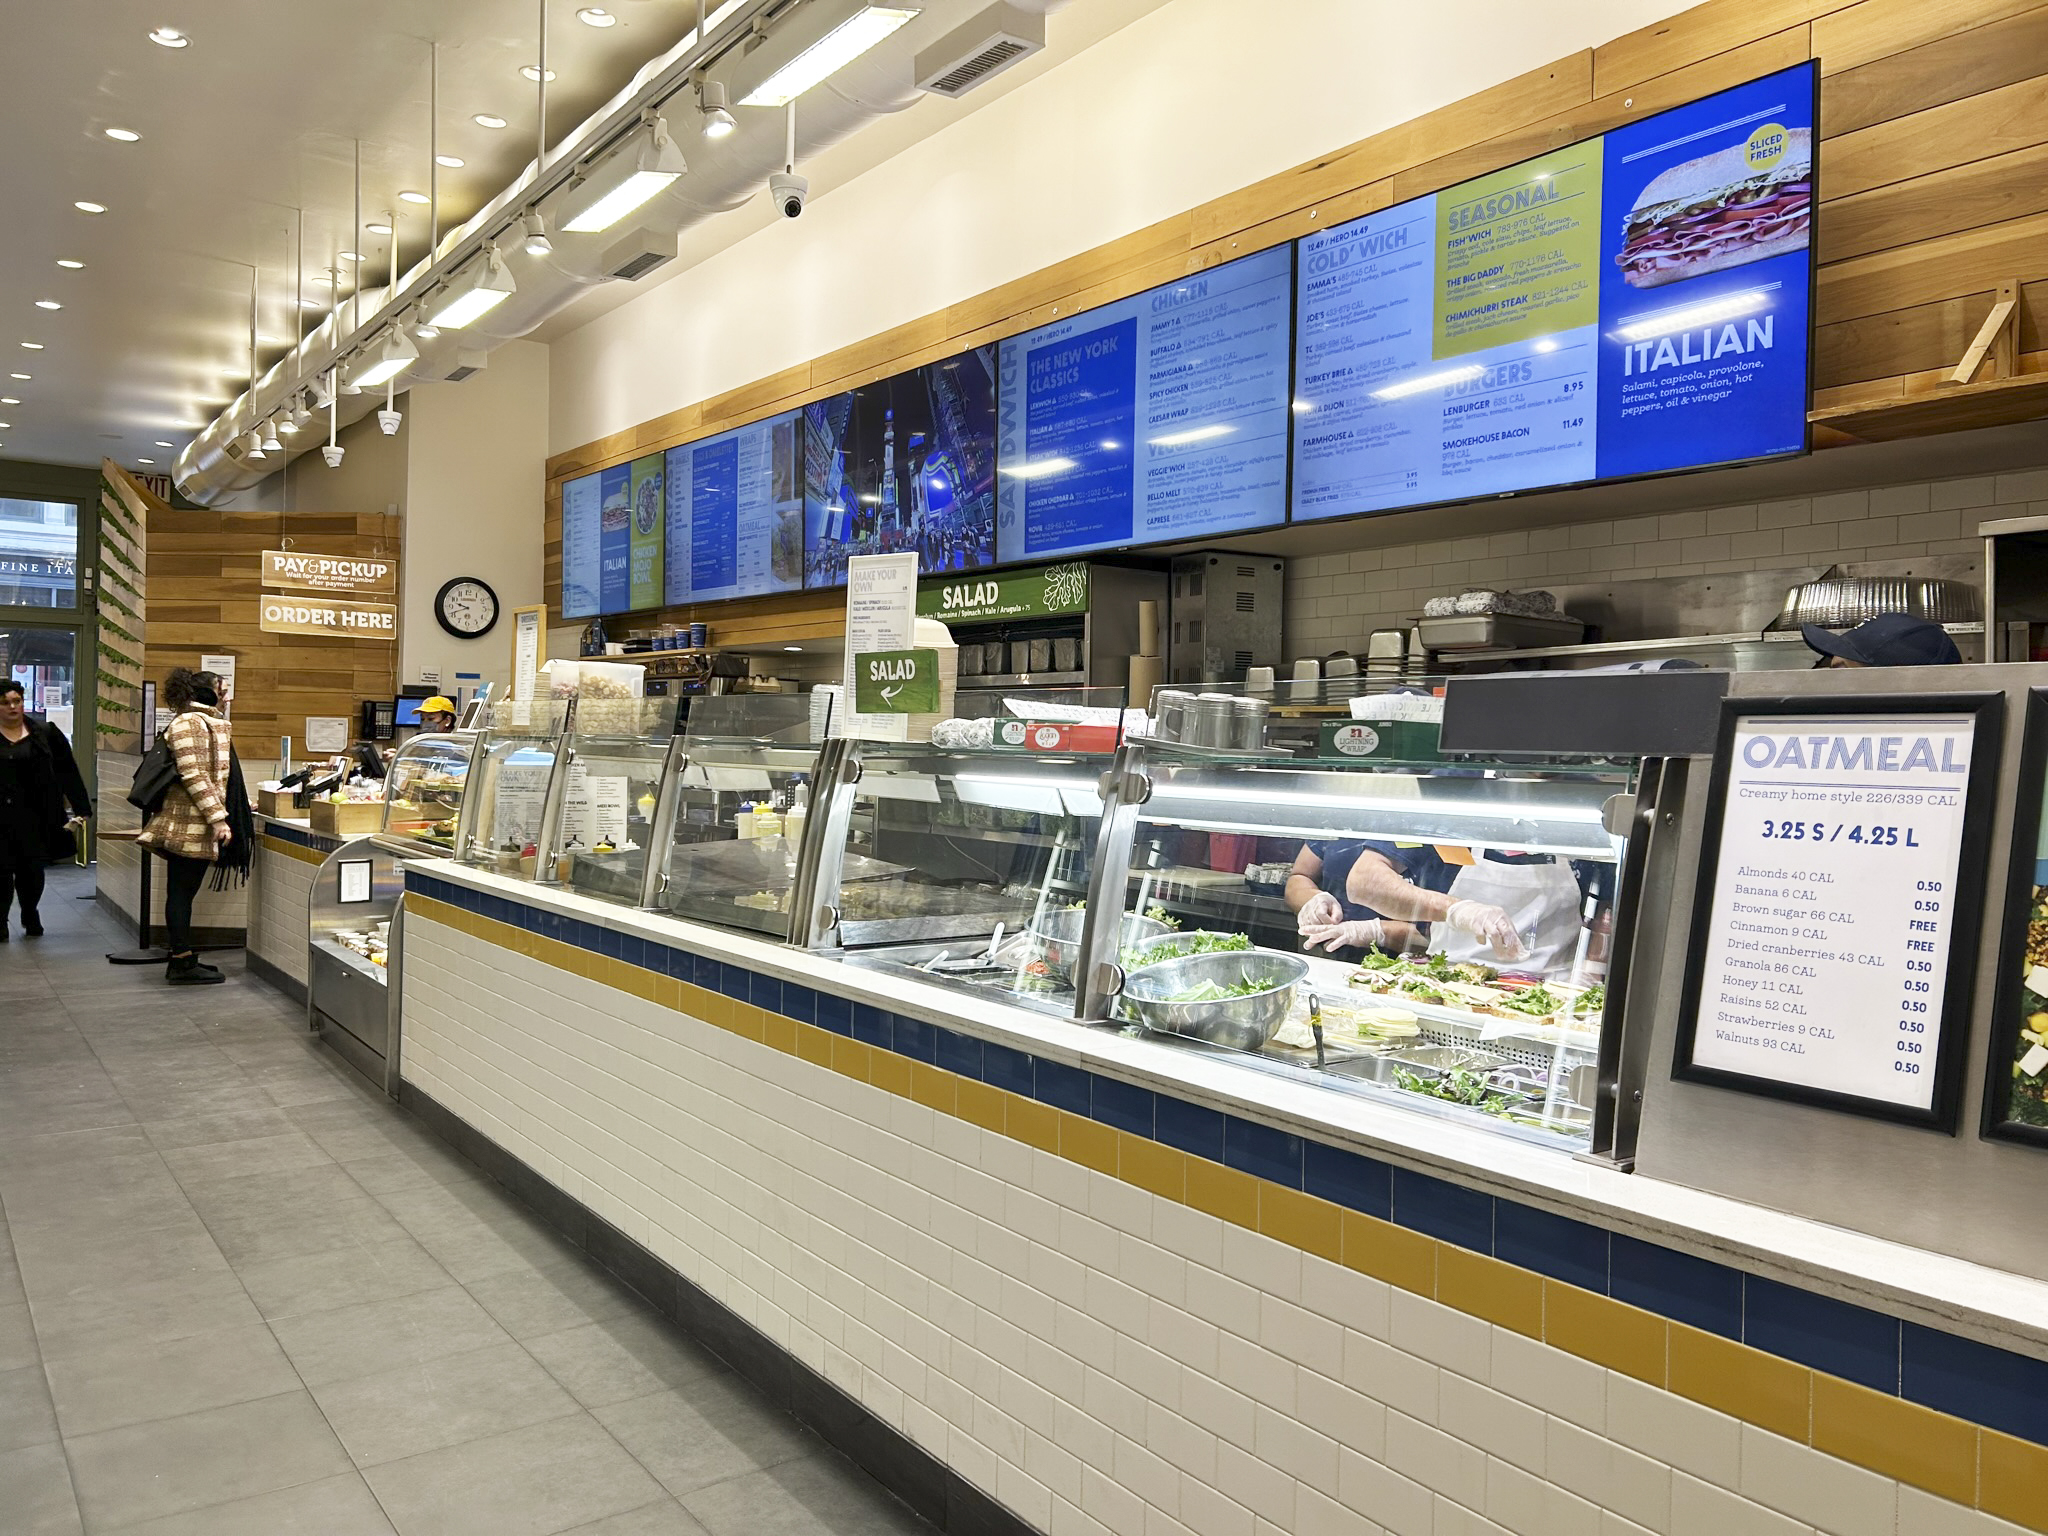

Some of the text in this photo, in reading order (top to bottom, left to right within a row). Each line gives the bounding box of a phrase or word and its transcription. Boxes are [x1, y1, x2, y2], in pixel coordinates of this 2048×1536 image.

[1750, 133, 1783, 151] SLICED
[1750, 145, 1782, 162] FRESH
[1448, 180, 1560, 231] SEASONAL
[1307, 225, 1369, 253] 12.49 HERO 14.49
[1447, 213, 1546, 249] FISH'WICH CAL
[1359, 227, 1408, 258] WICH
[1446, 249, 1564, 288] THE BIG DADDY CAL
[1307, 276, 1337, 292] EMMA'S
[1151, 279, 1209, 313] CHICKEN
[1446, 302, 1499, 323] CHIMICHURRI
[1501, 295, 1529, 309] STEAK
[1571, 280, 1589, 291] CAL
[1306, 311, 1325, 323] JOE'S
[1151, 319, 1170, 333] JIMMY
[1150, 343, 1176, 357] BUFFALO
[1624, 315, 1774, 376] ITALIAN
[1030, 335, 1119, 377] THE NEW YORK
[1030, 366, 1080, 395] CLASSICS
[1149, 364, 1187, 381] PARMIGIANA
[1304, 368, 1346, 385] TURKEY BRIE
[1622, 360, 1764, 393] Salami, capicola, provolone,
[1149, 383, 1189, 400] SPICY CHICKEN
[1622, 373, 1753, 404] lettuce, tomato, onion, hot
[1323, 400, 1345, 412] DIJON
[1443, 381, 1584, 417] LENBURGER 8.95
[1621, 390, 1732, 418] peppers, oil & vinegar
[1148, 411, 1170, 424] CAESAR
[1170, 407, 1189, 419] WRAP
[998, 343, 1017, 529] SADWICH
[1302, 431, 1347, 447] FARMHOUSE
[1442, 417, 1584, 450] SMOKEHOUSE BACON 11.49
[1165, 488, 1181, 498] MELT
[1146, 514, 1170, 526] CAPRESE
[0, 561, 39, 573] FINE
[603, 555, 627, 572] ITALIAN
[633, 559, 652, 572] MOJO
[286, 571, 302, 579] Wait
[633, 571, 652, 585] BOWL
[854, 568, 897, 581] MAKE YOUR
[325, 580, 355, 588] payment
[854, 581, 873, 593] OWN
[942, 581, 999, 610] SALAD
[264, 605, 393, 629] ORDER HERE
[937, 611, 958, 619] Romaine
[961, 607, 981, 618] Spinach
[985, 606, 996, 615] Kale
[1000, 604, 1021, 615] Arugula
[869, 658, 916, 682] SALAD
[1339, 737, 1375, 746] LIGHTNING
[1346, 745, 1366, 753] WRAP
[1743, 736, 1965, 773] OATMEAL
[1739, 788, 1957, 806] Creamy home style 226/339 CAL
[1762, 820, 1919, 848] 3.25 S / 4.25 L
[1737, 866, 1835, 884] Almonds 40 CAL
[1735, 884, 1817, 901] Banana 6 CAL
[1917, 880, 1942, 892] 0.50
[1732, 902, 1855, 924] Brown sugar 66 CAL
[1914, 900, 1940, 912] 0.50
[1730, 920, 1828, 940] Cinnamon 9 CAL
[1909, 920, 1938, 932] FREE
[1727, 938, 1885, 967] Dried cranberries 43 CAL
[1906, 940, 1935, 952] FREE
[1725, 956, 1817, 978] Granola 86 CAL
[1906, 960, 1932, 972] 0.50
[1722, 975, 1804, 995] Honey 11 CAL
[1904, 980, 1930, 993] 0.50
[1720, 993, 1807, 1015] Raisins 52 CAL
[1901, 1000, 1927, 1013] 0.50
[1717, 1011, 1835, 1040] Strawberries 9 CAL
[1899, 1020, 1925, 1033] 0.50
[1715, 1029, 1806, 1054] Walnuts 93 CAL
[1897, 1040, 1922, 1054] 0.50
[1894, 1061, 1920, 1074] 0.50
